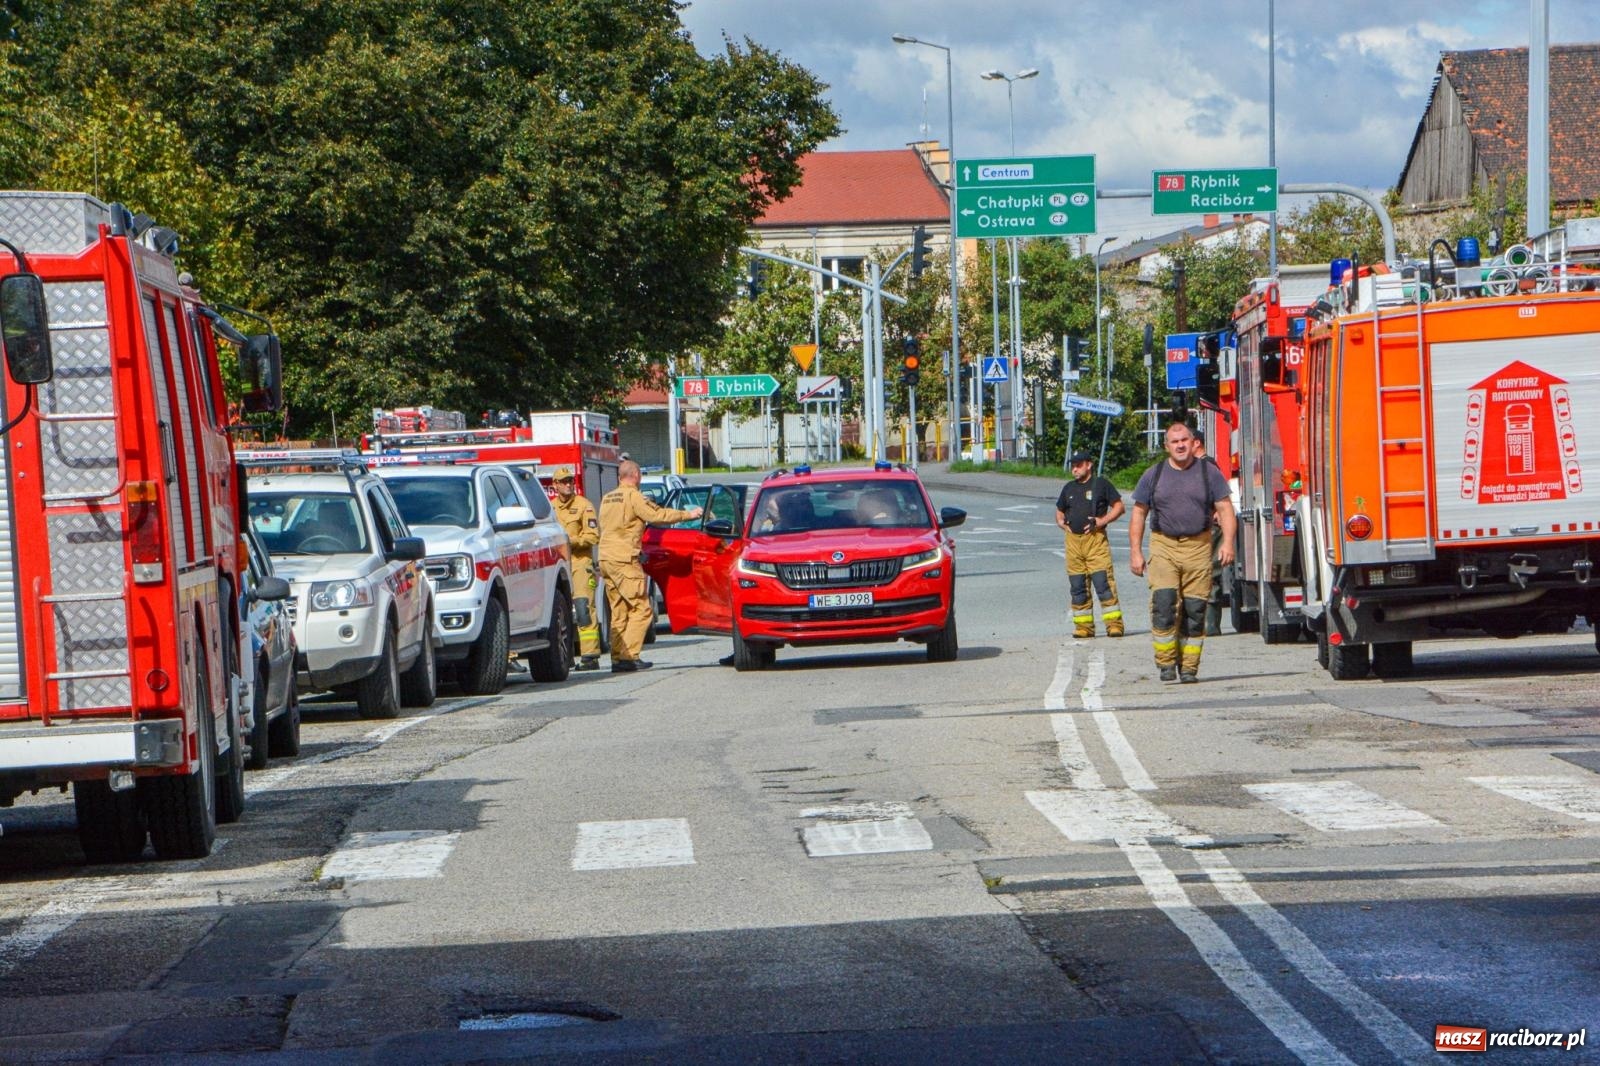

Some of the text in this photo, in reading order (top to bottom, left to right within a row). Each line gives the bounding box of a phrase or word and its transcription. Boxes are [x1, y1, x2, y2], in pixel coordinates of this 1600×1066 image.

[982, 167, 1030, 178] Centrum
[1165, 174, 1241, 192] 78 Rybnik
[977, 194, 1085, 212] Chałupki PL CZ
[1191, 192, 1255, 207] Racibórz
[977, 214, 1064, 229] Ostrava CZ
[1172, 351, 1183, 360] 78
[688, 379, 766, 396] 78 Rybnik
[1496, 377, 1539, 389] KORYTARZ
[1491, 389, 1544, 402] RATUNKOWY
[1086, 401, 1116, 412] Dworzec
[1507, 434, 1522, 445] 998
[1509, 444, 1522, 457] 112
